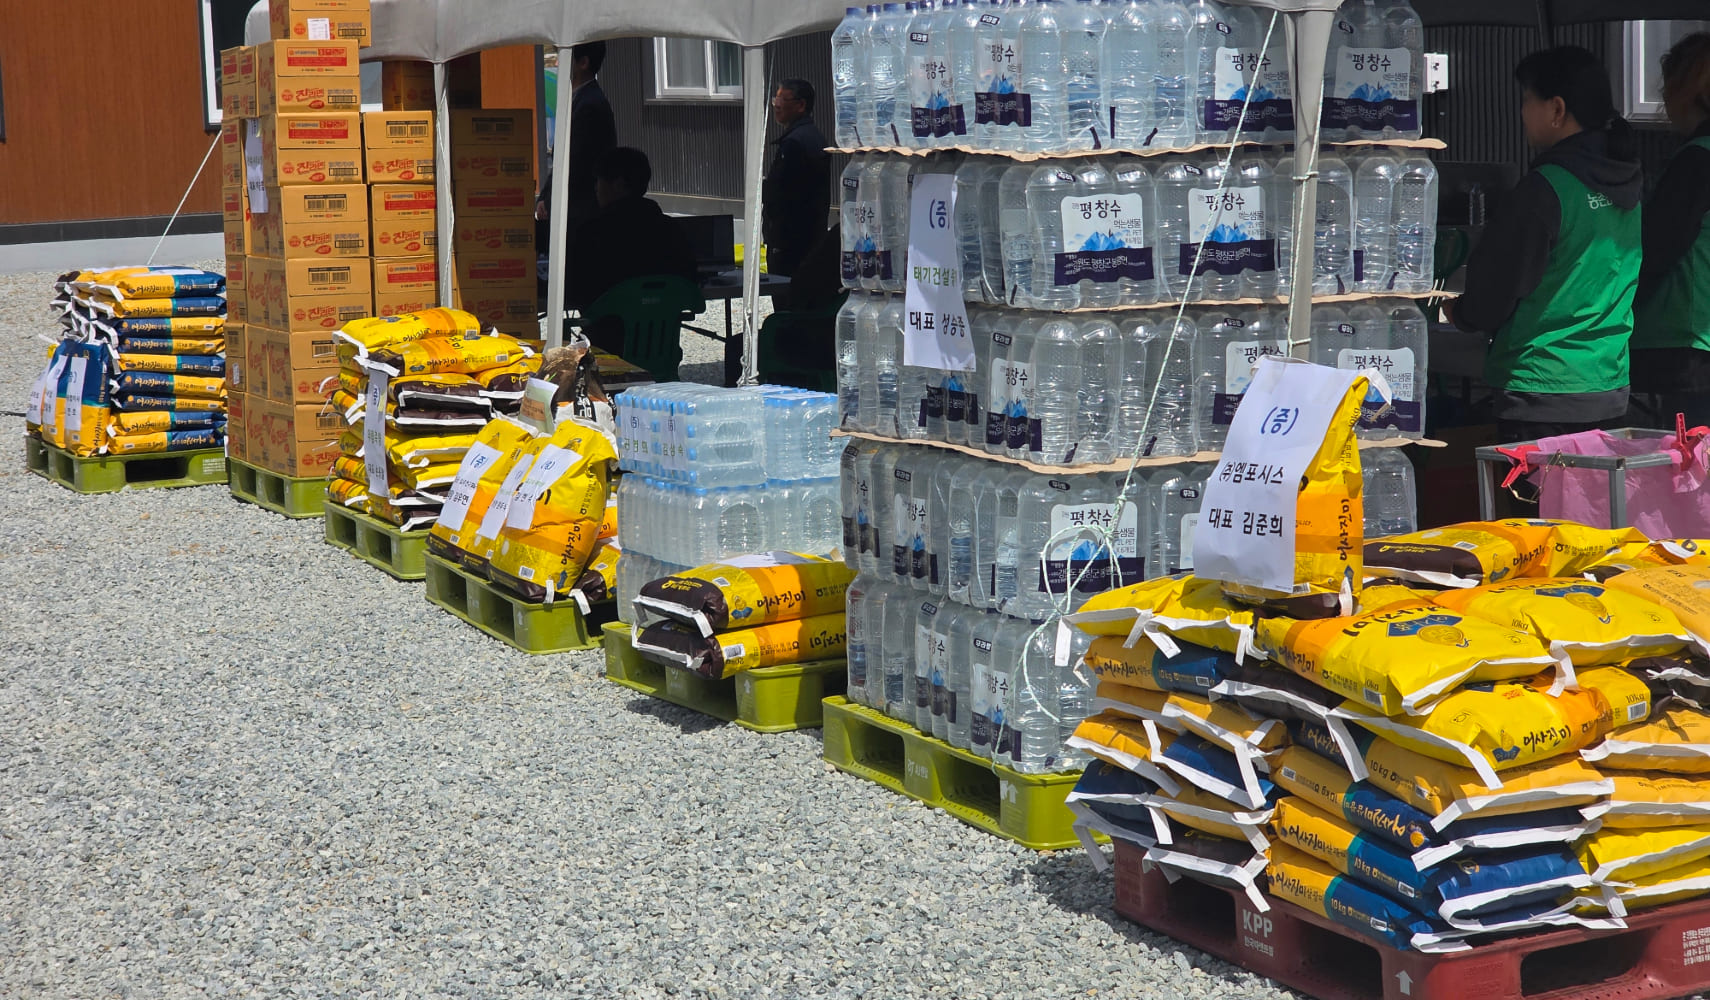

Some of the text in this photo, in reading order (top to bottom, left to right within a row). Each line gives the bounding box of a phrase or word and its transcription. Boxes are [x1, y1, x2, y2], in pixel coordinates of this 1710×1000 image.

[1232, 53, 1271, 72] 평창수
[1352, 53, 1391, 72] 평창수
[1080, 200, 1121, 220] 평창수
[909, 311, 935, 331] 대표
[1261, 407, 1298, 435] (증)
[1070, 509, 1113, 528] 평창수
[1208, 508, 1283, 537] 대표 김준희
[1339, 499, 1353, 561] 어사진미
[561, 522, 582, 565] 어사진미
[1513, 545, 1545, 569] 어사진
[757, 591, 807, 614] 어사진미
[809, 631, 847, 648] 사진미
[1104, 661, 1138, 683] 어사진미
[1279, 646, 1315, 674] 어사진미
[1523, 724, 1572, 753] 어사진미
[1308, 726, 1389, 780] 어사진 10kg
[1321, 785, 1339, 804] 10kg
[1364, 806, 1407, 839] 어사진미
[1289, 824, 1326, 853] 어사진미
[1354, 856, 1371, 874] 10kg
[1275, 871, 1304, 898] 어사진미
[1331, 897, 1347, 915] 10kg
[1242, 908, 1273, 938] KPP
